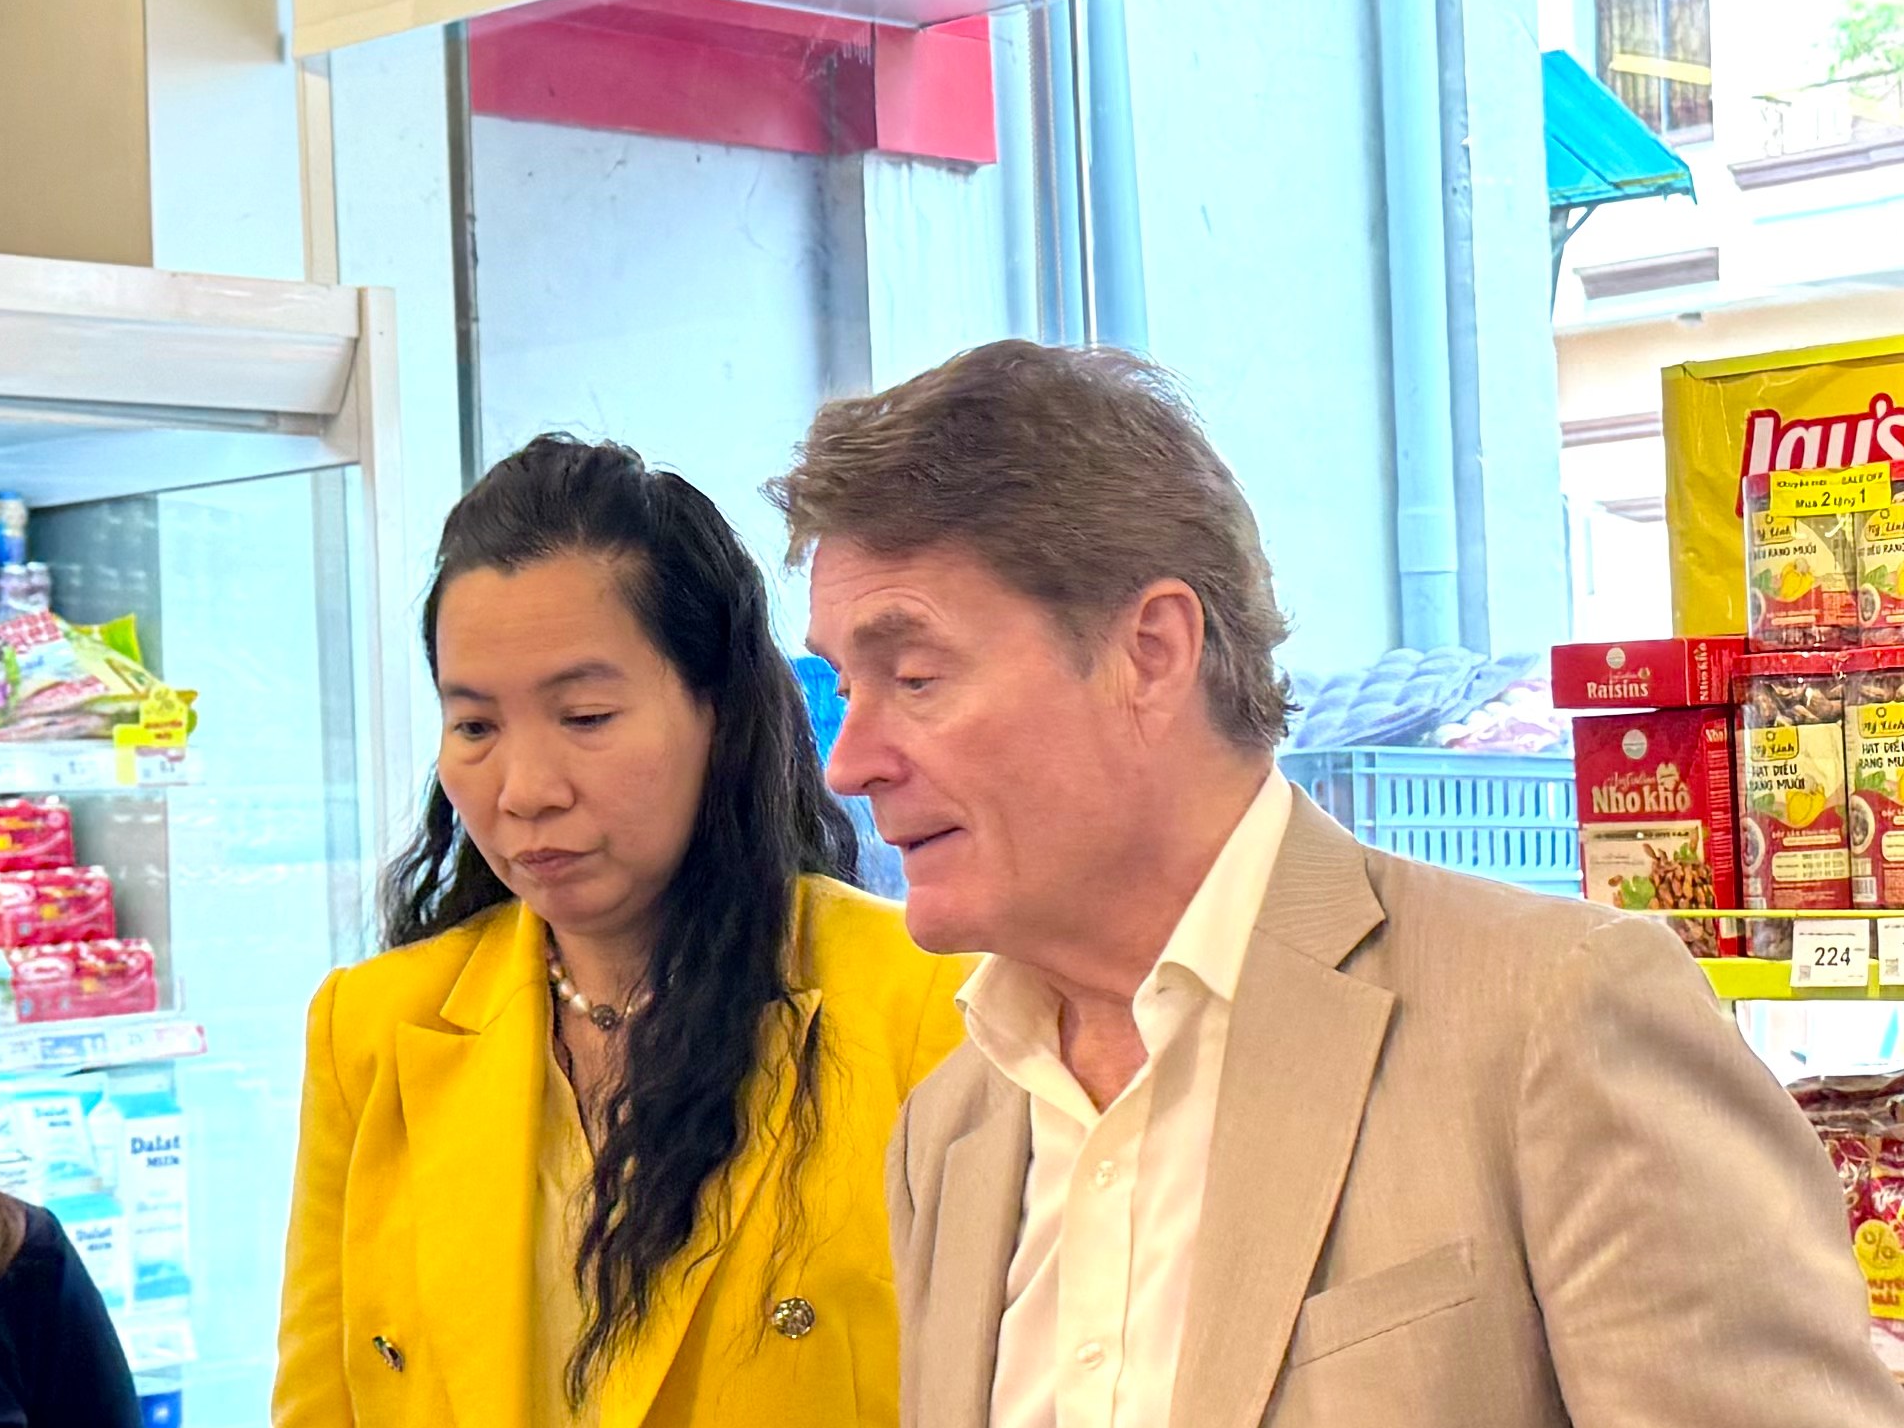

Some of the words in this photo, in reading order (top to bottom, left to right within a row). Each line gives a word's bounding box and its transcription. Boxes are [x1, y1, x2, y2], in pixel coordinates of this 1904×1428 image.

[1822, 491, 1831, 507] 2
[1587, 680, 1649, 700] Raisins
[1814, 946, 1851, 967] 224
